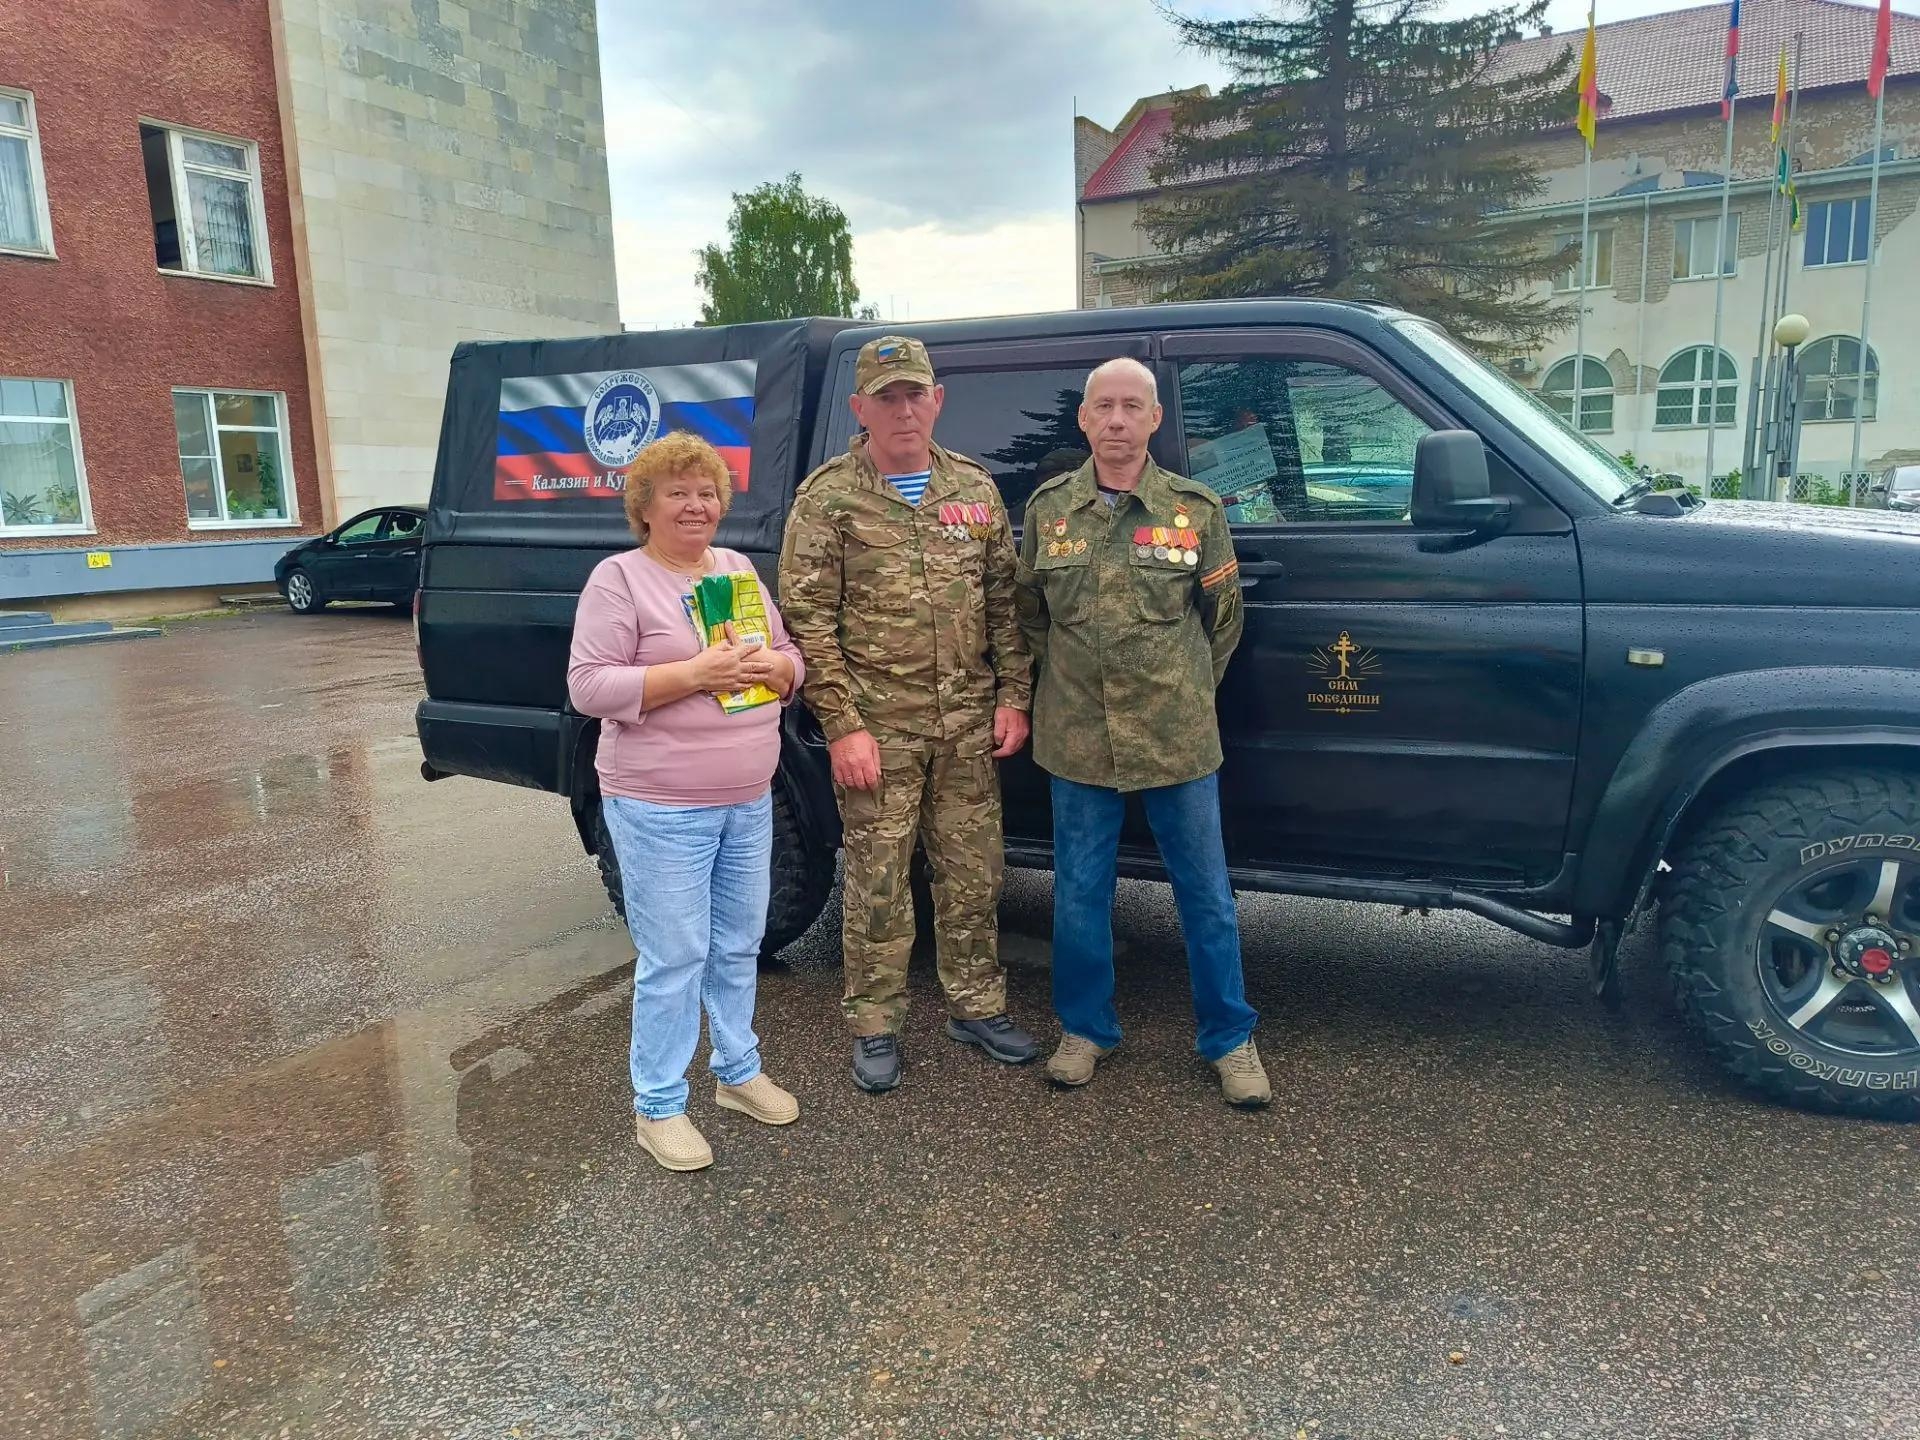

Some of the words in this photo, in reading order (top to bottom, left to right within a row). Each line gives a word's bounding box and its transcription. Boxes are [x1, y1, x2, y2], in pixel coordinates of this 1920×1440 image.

[594, 373, 653, 399] СОДРУЖЕСТВО
[532, 474, 590, 491] Калязин
[593, 475, 603, 488] и
[1328, 680, 1359, 691] СИМ
[1307, 693, 1380, 705] ПОБЕДИШИ
